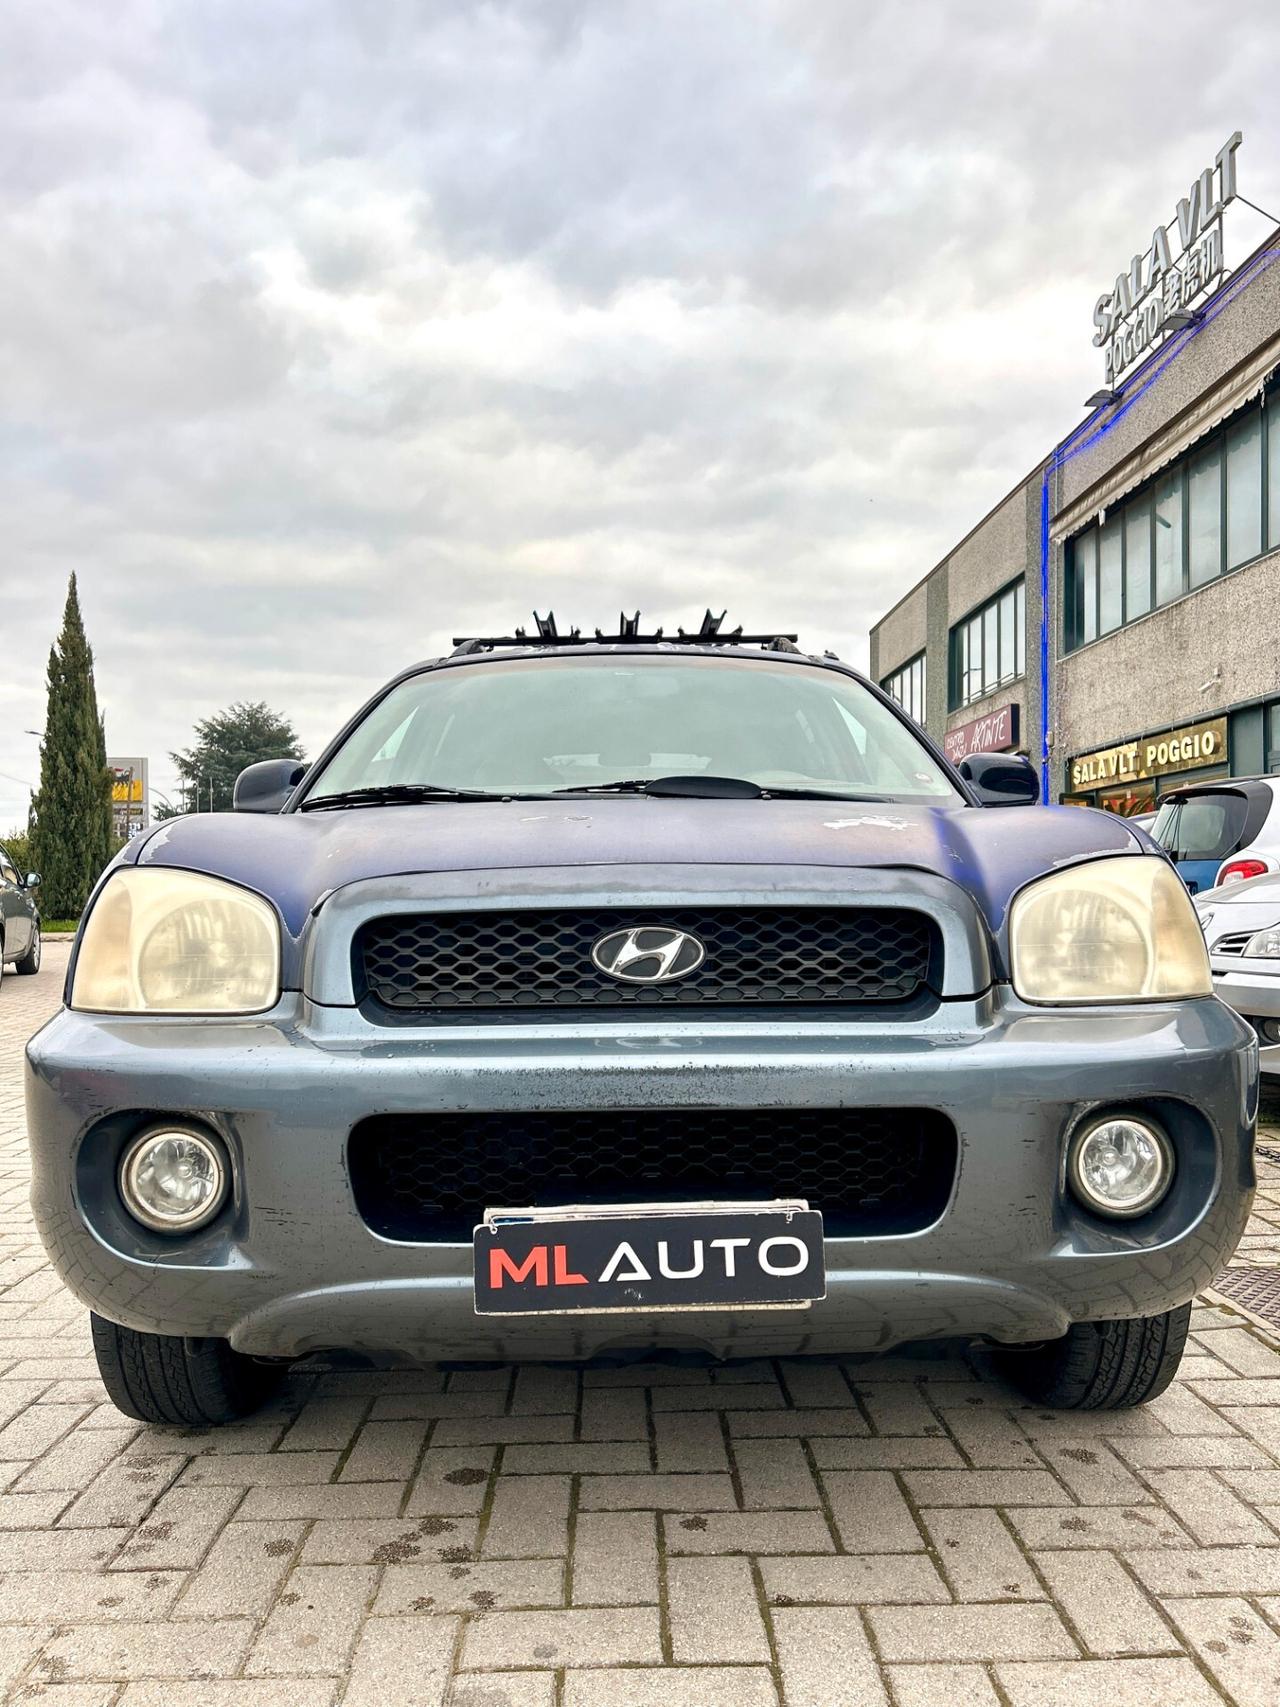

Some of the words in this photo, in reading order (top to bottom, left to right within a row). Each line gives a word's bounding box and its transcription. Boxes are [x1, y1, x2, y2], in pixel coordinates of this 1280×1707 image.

[1092, 225, 1173, 348] SALA
[1176, 131, 1243, 251] VLT
[1105, 297, 1164, 384] POGGIO
[1073, 757, 1107, 785] SALA
[1109, 751, 1136, 776] VLT
[1146, 731, 1215, 767] POGGIO
[489, 1245, 589, 1289] ML
[597, 1236, 809, 1283] AUTO
